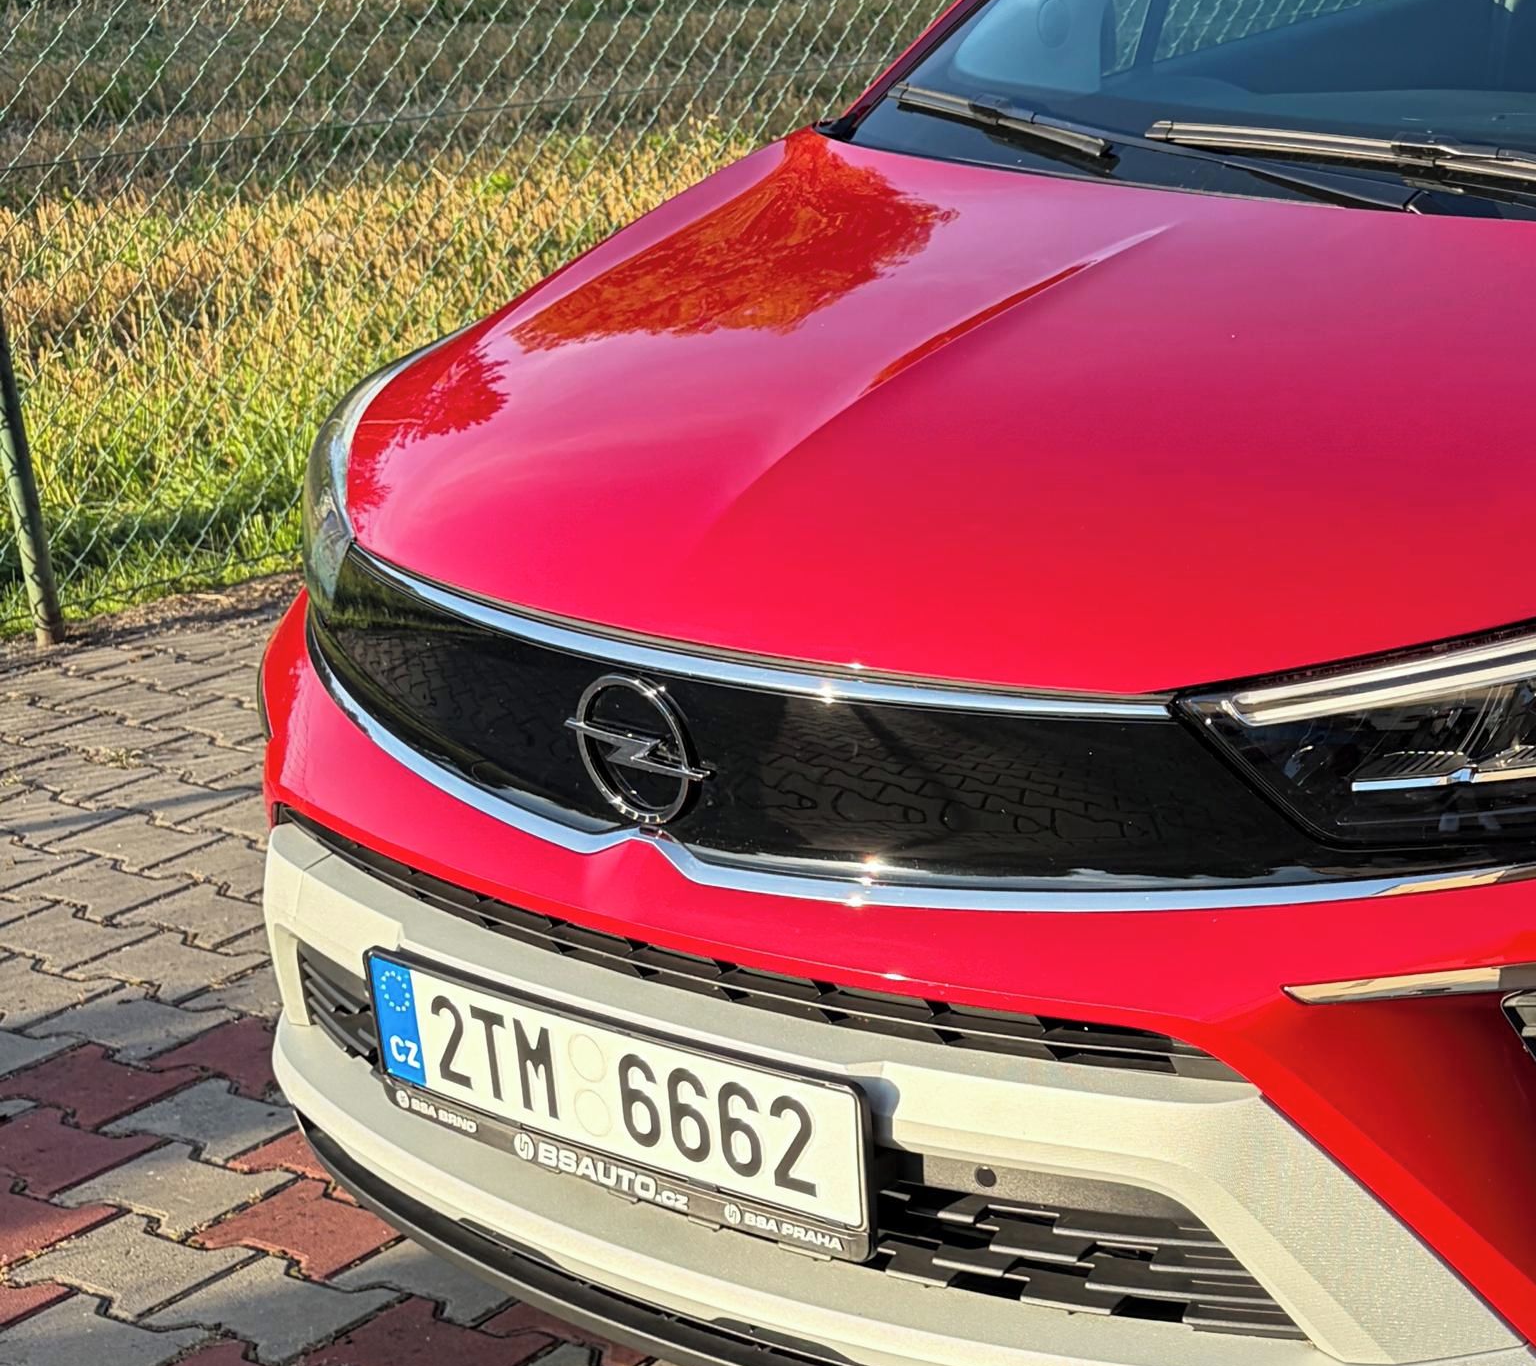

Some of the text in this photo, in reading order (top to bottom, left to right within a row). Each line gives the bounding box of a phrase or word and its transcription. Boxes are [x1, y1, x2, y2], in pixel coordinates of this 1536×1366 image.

[389, 1035, 421, 1069] CZ
[431, 995, 817, 1198] 2TM 6662
[437, 1109, 478, 1133] BRNO
[781, 1223, 844, 1251] PRAHA
